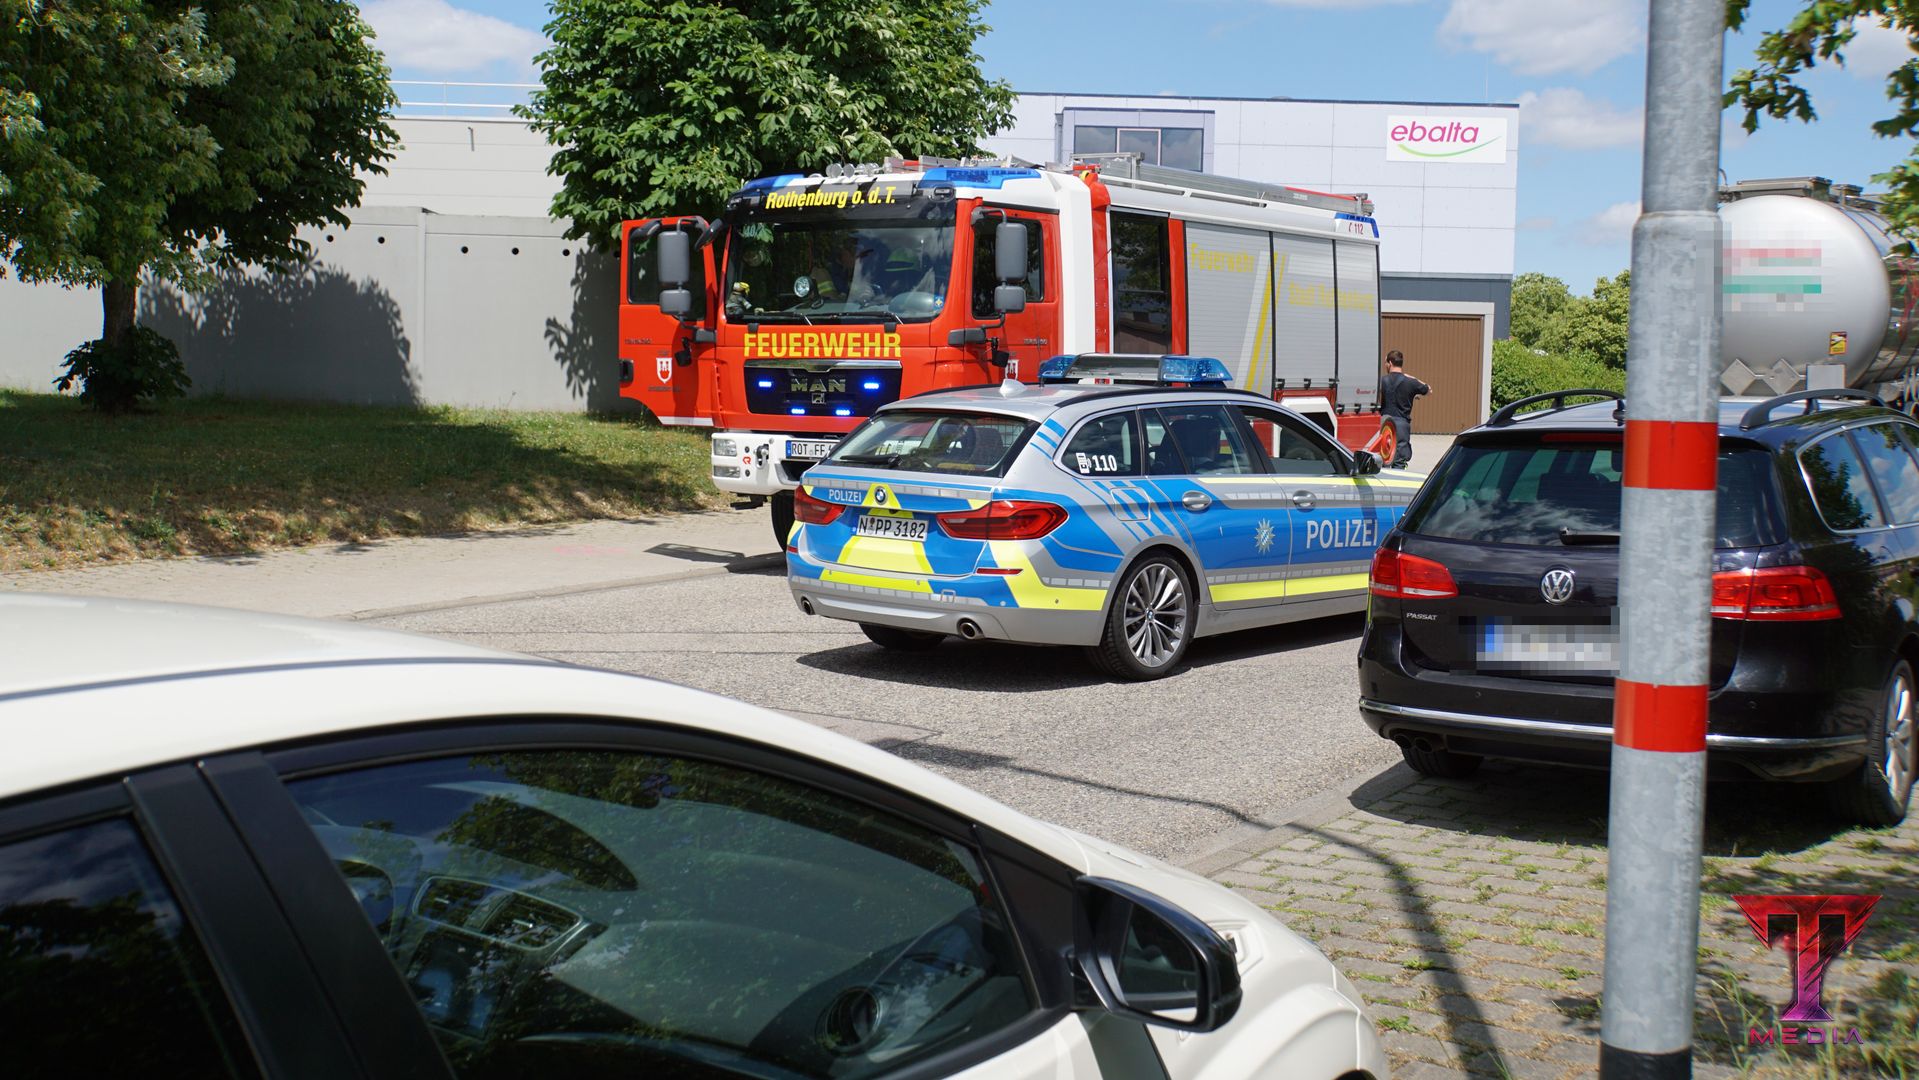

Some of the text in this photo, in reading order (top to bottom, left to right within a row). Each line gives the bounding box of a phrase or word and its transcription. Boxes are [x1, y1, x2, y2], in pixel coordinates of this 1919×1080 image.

[1390, 120, 1479, 143] ebalta
[765, 186, 896, 209] Rothenburg o. d. T.
[743, 332, 902, 358] FEUERWEHR
[791, 378, 846, 392] MAN
[791, 443, 809, 456] ROT
[814, 444, 825, 456] FF
[1091, 454, 1118, 471] 110
[828, 488, 862, 503] POLIZEI
[859, 517, 926, 539] N PP 3182
[1306, 519, 1378, 549] POLIZEI
[1406, 612, 1438, 621] PASSAT
